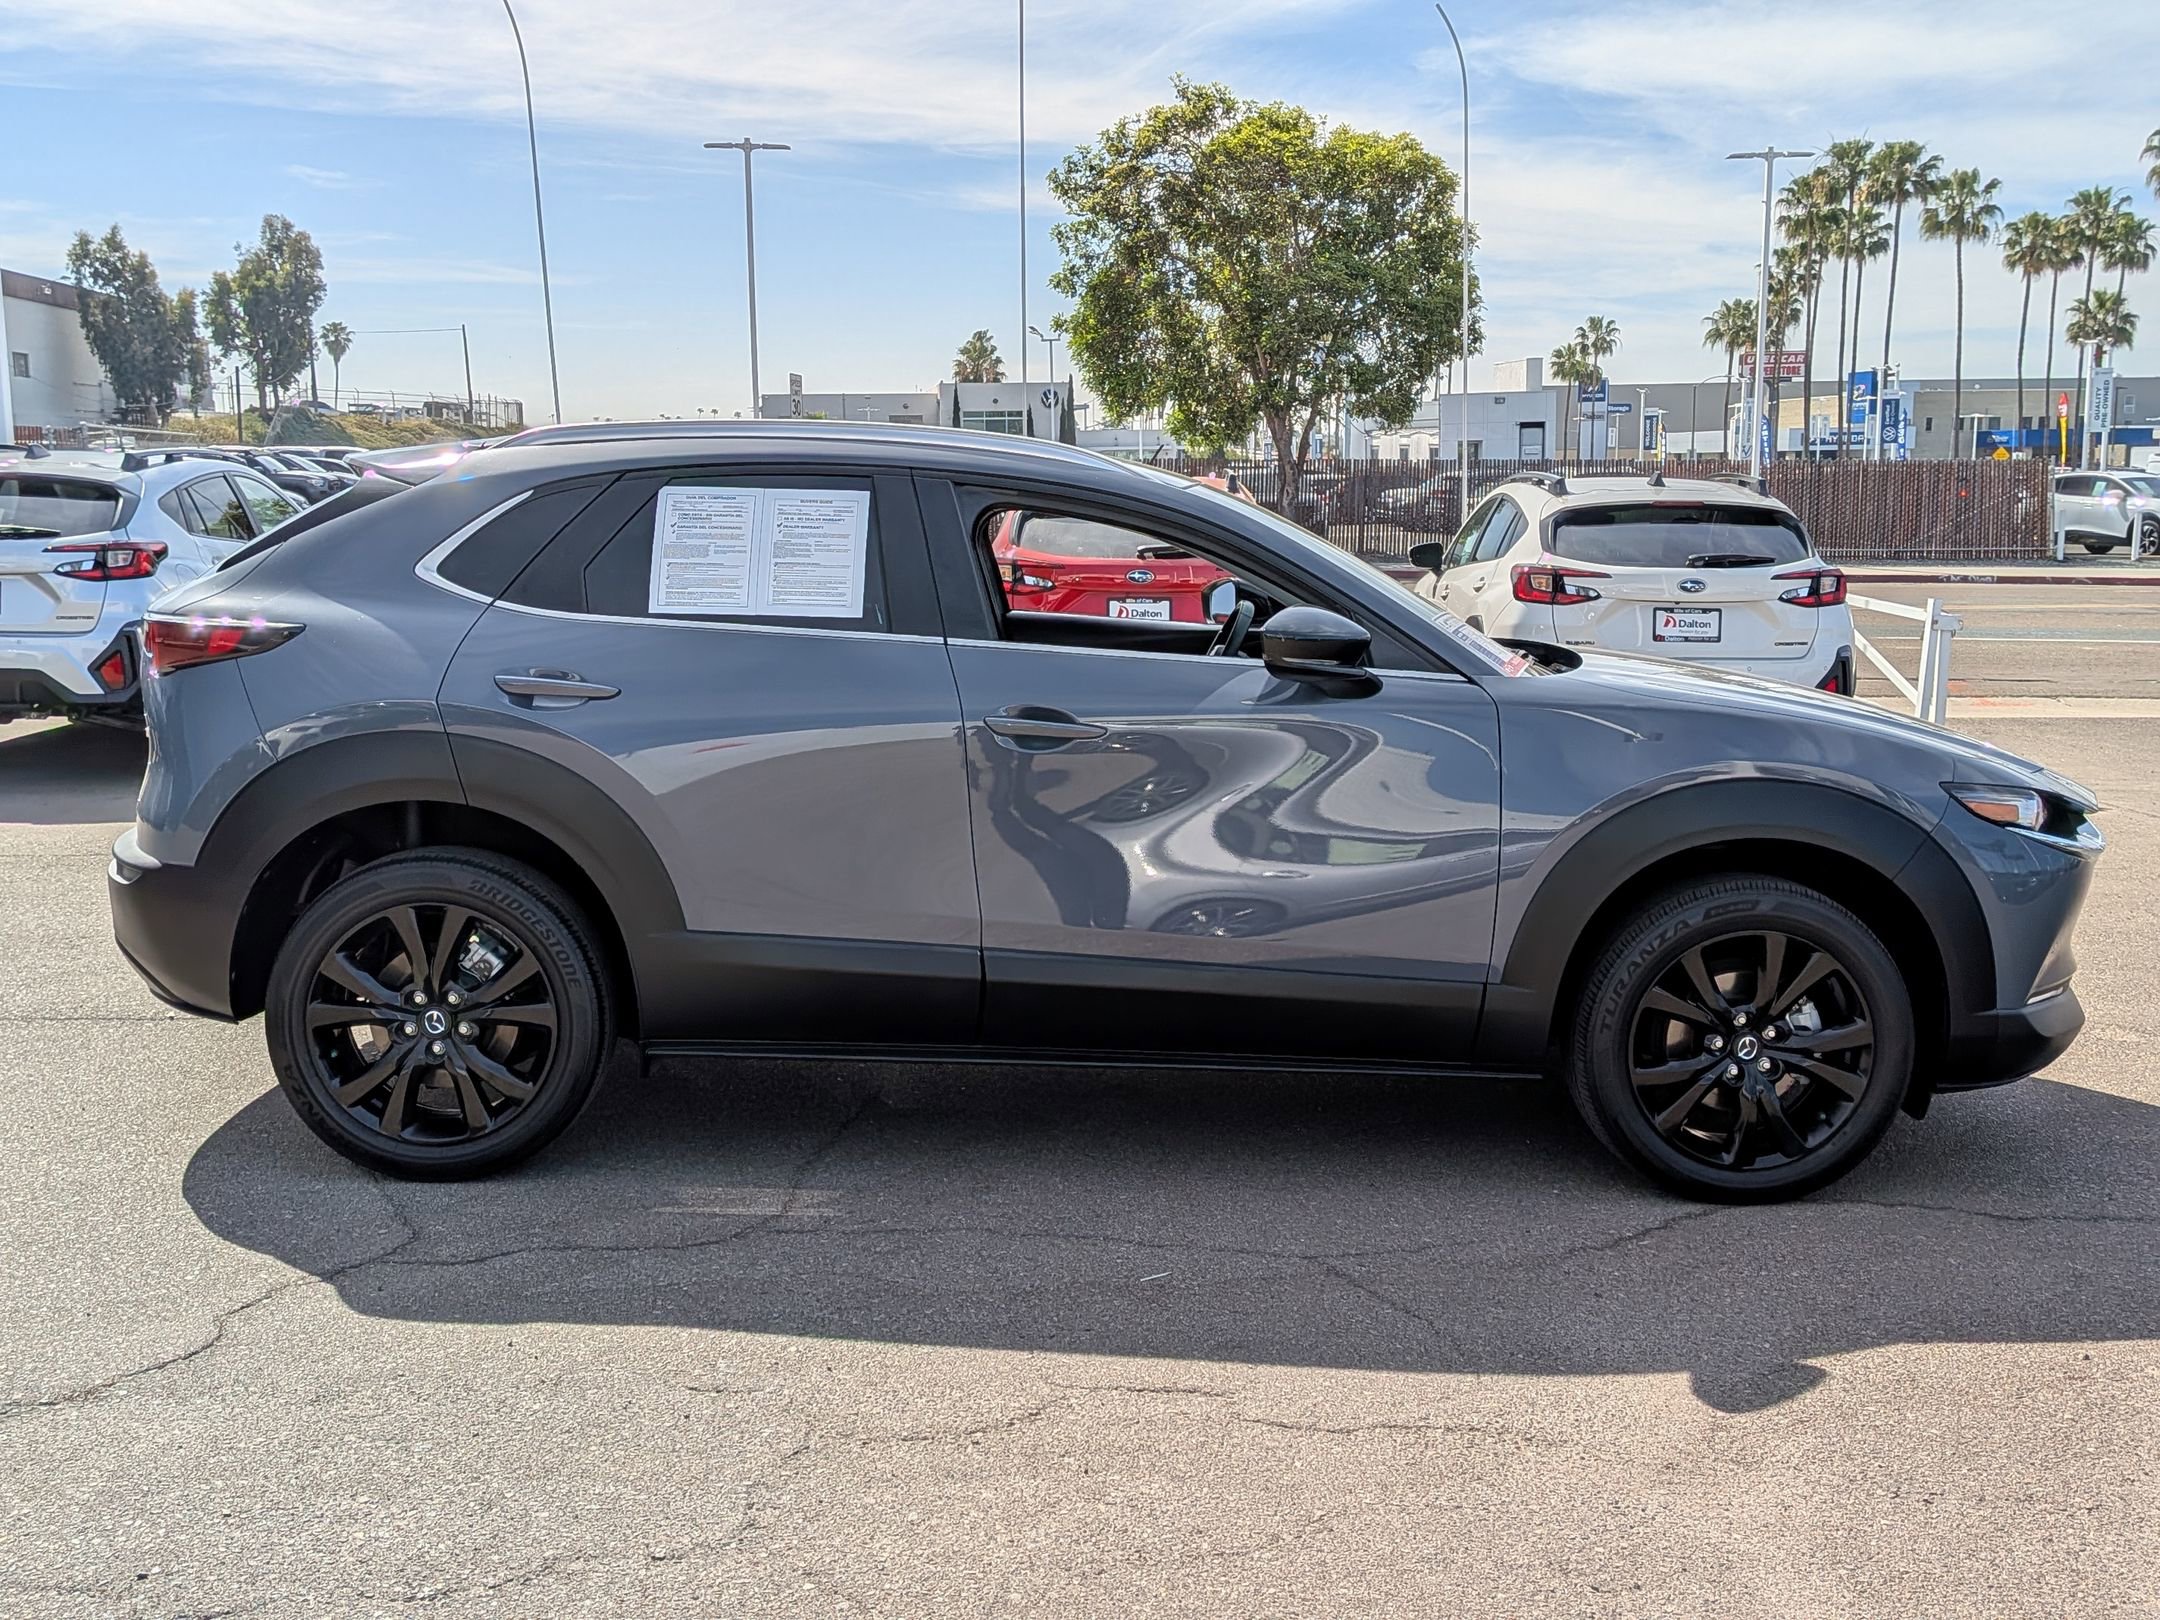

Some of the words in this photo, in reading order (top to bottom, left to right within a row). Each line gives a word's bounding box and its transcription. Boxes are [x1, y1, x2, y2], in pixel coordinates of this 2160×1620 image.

[1746, 354, 1776, 363] UED
[1781, 354, 1806, 363] CAR
[792, 398, 802, 417] 30
[2094, 386, 2102, 421] QUALITY
[2101, 379, 2111, 428] PRE-OWNED
[1131, 609, 1163, 618] Dalton
[1678, 619, 1712, 629] Dalton
[467, 879, 582, 989] BRIDGESTONE
[1599, 918, 1693, 1035] TURANZA
